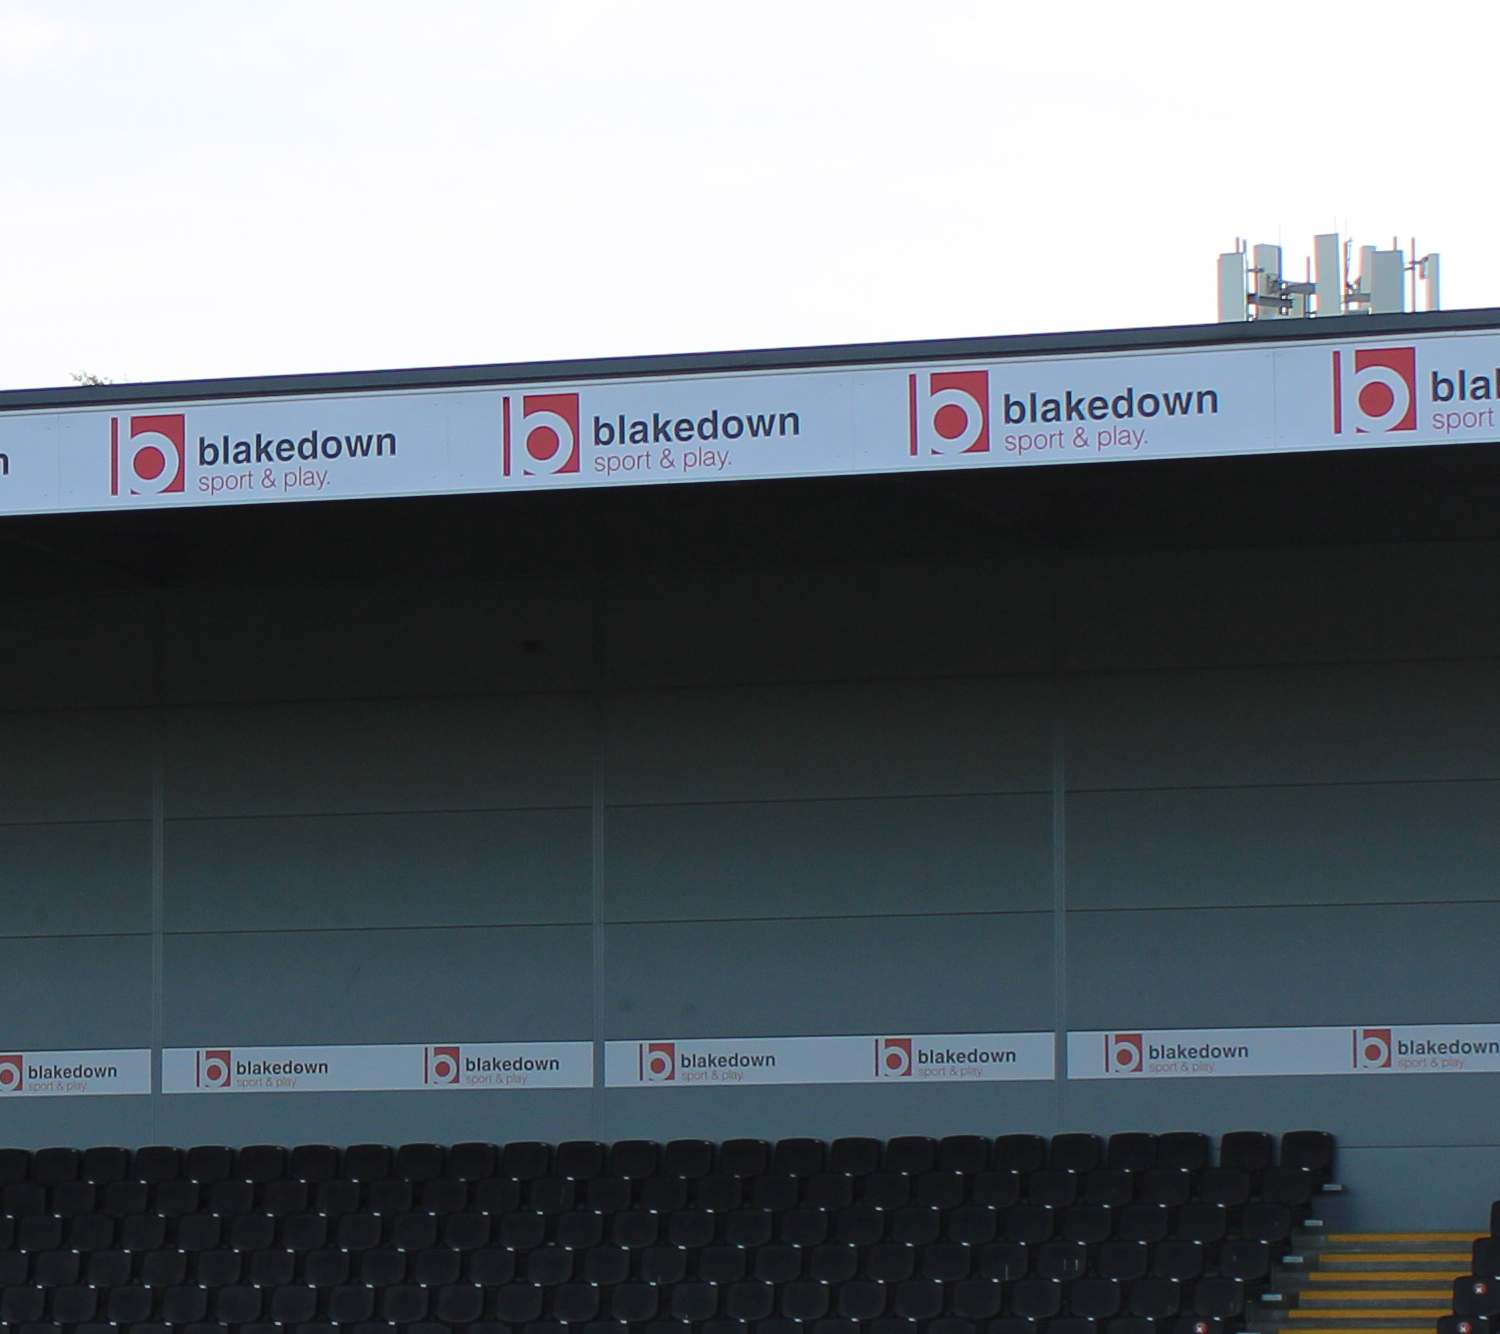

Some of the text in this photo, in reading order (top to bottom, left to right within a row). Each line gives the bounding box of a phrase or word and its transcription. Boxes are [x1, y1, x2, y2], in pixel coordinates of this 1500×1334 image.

[1004, 387, 1218, 425] blakedown
[594, 409, 799, 447] blakedown
[1433, 407, 1494, 434] sport
[199, 430, 396, 467] blakedown
[1005, 425, 1147, 456] sport & play.
[595, 446, 731, 476] sport & play.
[199, 465, 330, 496] sport & play.
[918, 1048, 1016, 1064] blakedown
[1149, 1043, 1248, 1060] blakedown
[1398, 1039, 1499, 1055] blakedown
[29, 1063, 117, 1079] blakedown
[237, 1059, 328, 1075] blakedown
[466, 1056, 559, 1072] blakedown
[681, 1052, 775, 1068] blakedown
